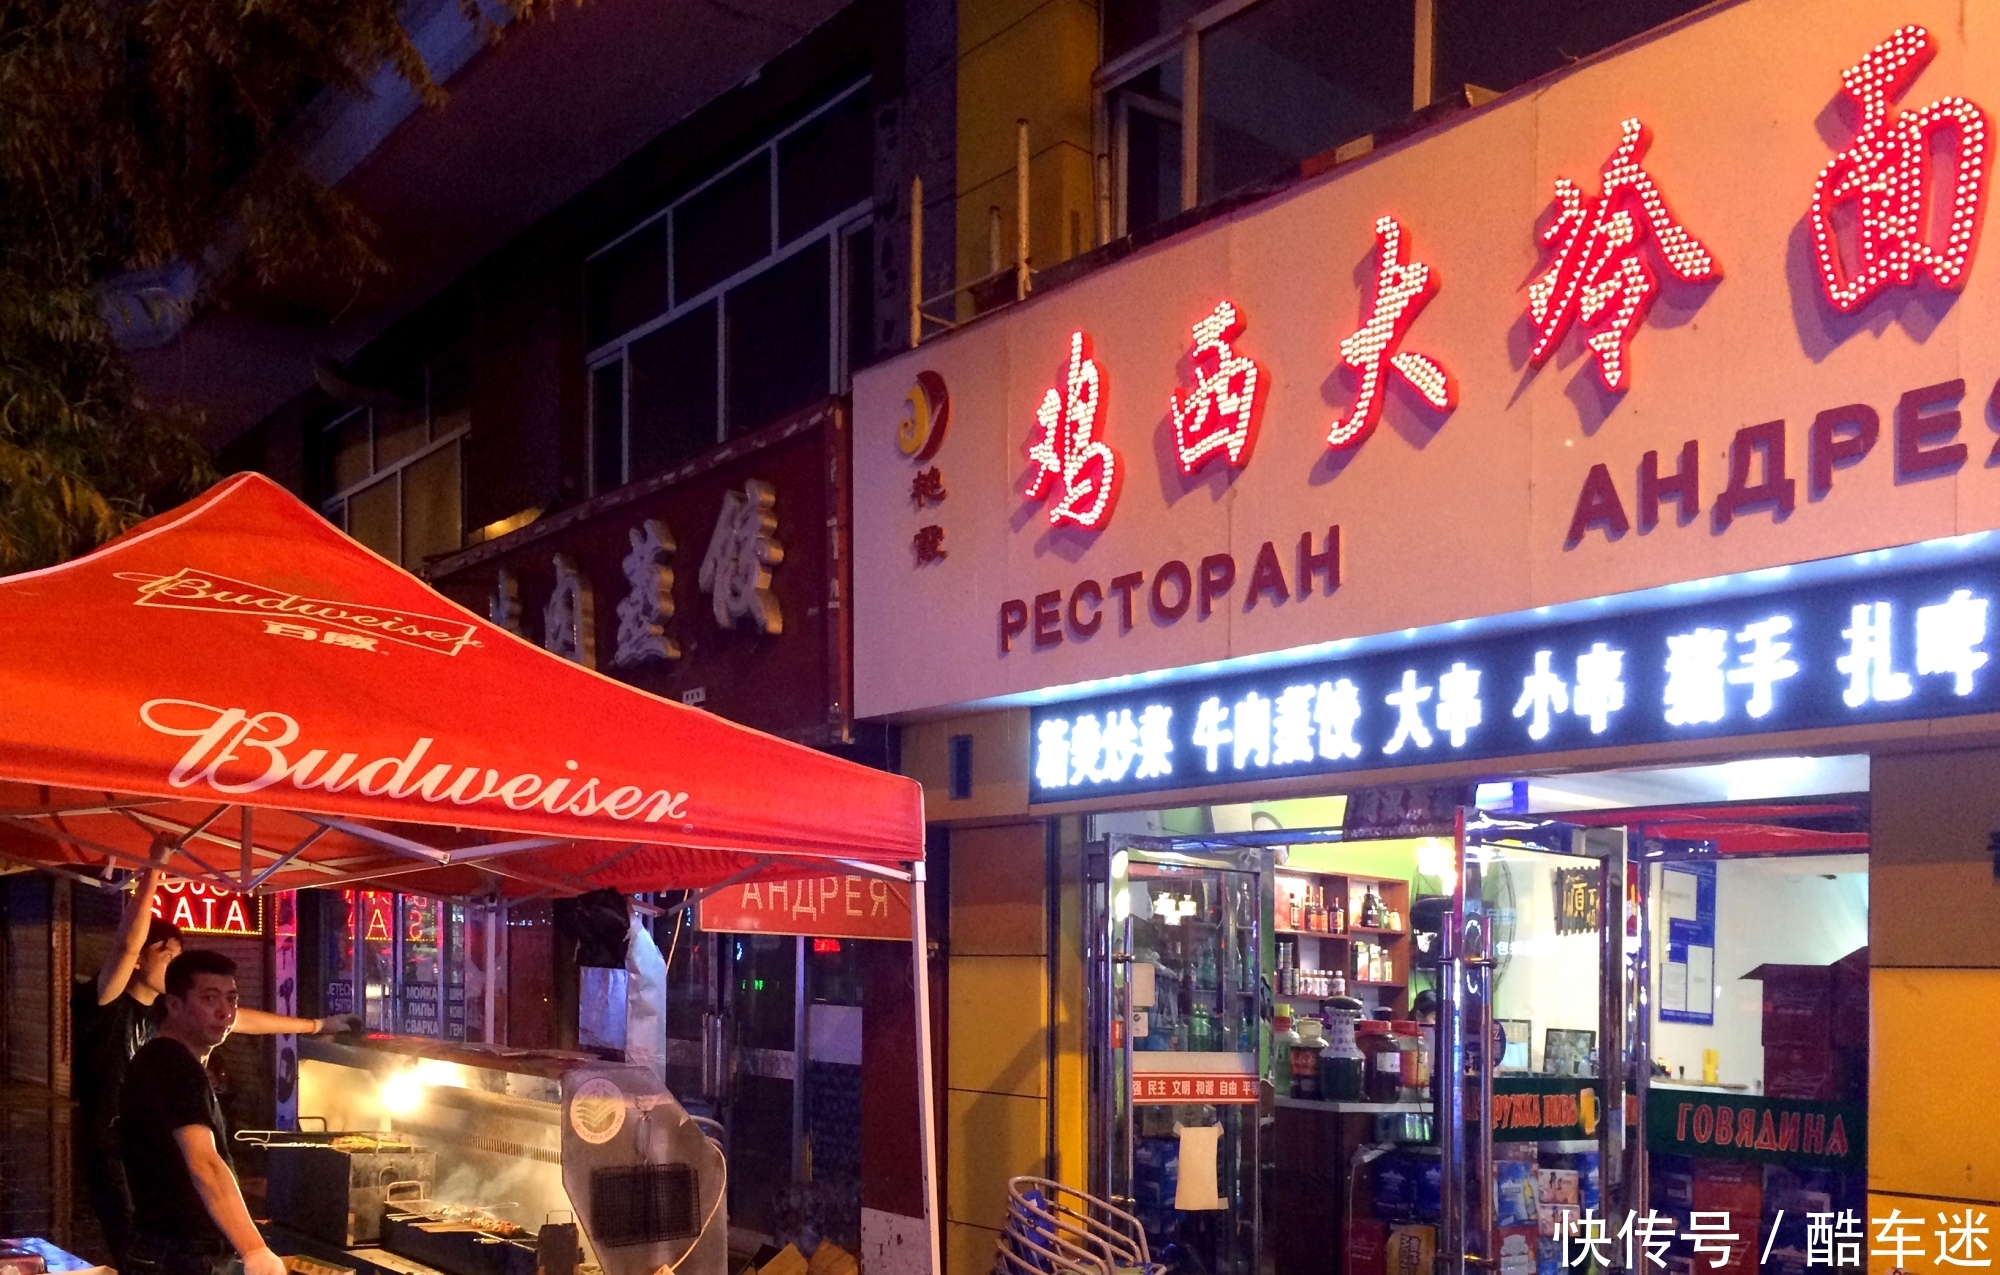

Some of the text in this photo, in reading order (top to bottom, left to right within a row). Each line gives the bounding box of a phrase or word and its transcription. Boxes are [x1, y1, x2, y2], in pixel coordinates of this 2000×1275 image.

[1025, 24, 1991, 530] 鸡西大冷面
[1000, 378, 2000, 653] РЕСТОРАН АНДРЕ
[113, 571, 484, 649] Budweiser
[1383, 662, 1482, 754] 大串
[1512, 642, 1625, 740] 小串
[1836, 589, 1989, 708] 扎啤
[140, 698, 689, 823] Budweiser
[741, 875, 888, 922] АНДРЕЯ
[406, 984, 438, 1000] МОЙКА
[405, 1019, 439, 1035] СВАРКА
[1148, 1081, 1167, 1096] 民主
[1172, 1081, 1191, 1096] 文明
[1196, 1081, 1214, 1096] 和谐
[1220, 1081, 1237, 1096] 自由
[1676, 1103, 1848, 1157] ГОВЯДИНА
